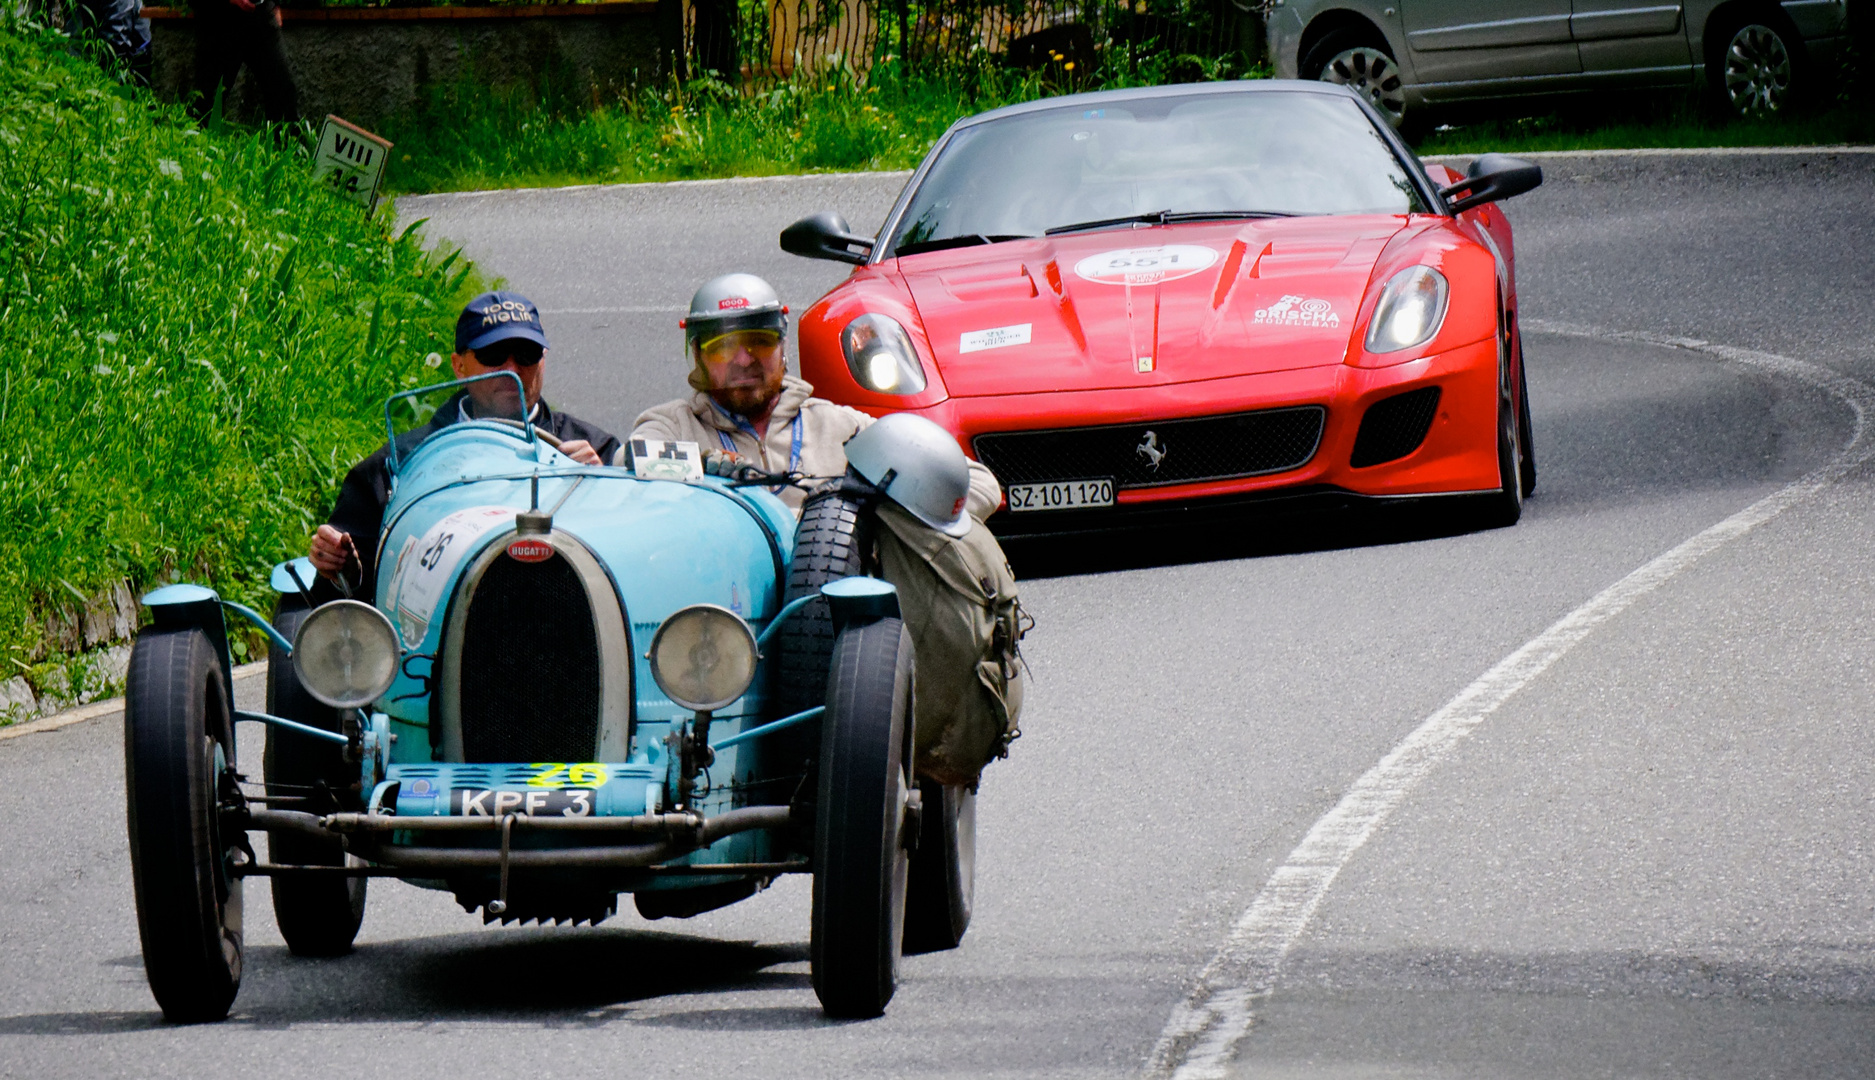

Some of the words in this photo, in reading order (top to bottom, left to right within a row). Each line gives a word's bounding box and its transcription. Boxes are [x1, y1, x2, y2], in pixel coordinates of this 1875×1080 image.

[335, 133, 373, 166] VIII
[1108, 254, 1179, 268] 551
[483, 301, 526, 314] 1000
[721, 298, 744, 307] 1000
[482, 311, 532, 327] MIGLIA
[1253, 317, 1339, 329] MODELLBAU
[1254, 309, 1340, 323] GRISCHA
[420, 532, 454, 572] 26
[511, 546, 550, 556] BUGATTI
[526, 762, 608, 788] 26
[461, 790, 550, 817] KPF
[562, 790, 591, 818] 3
